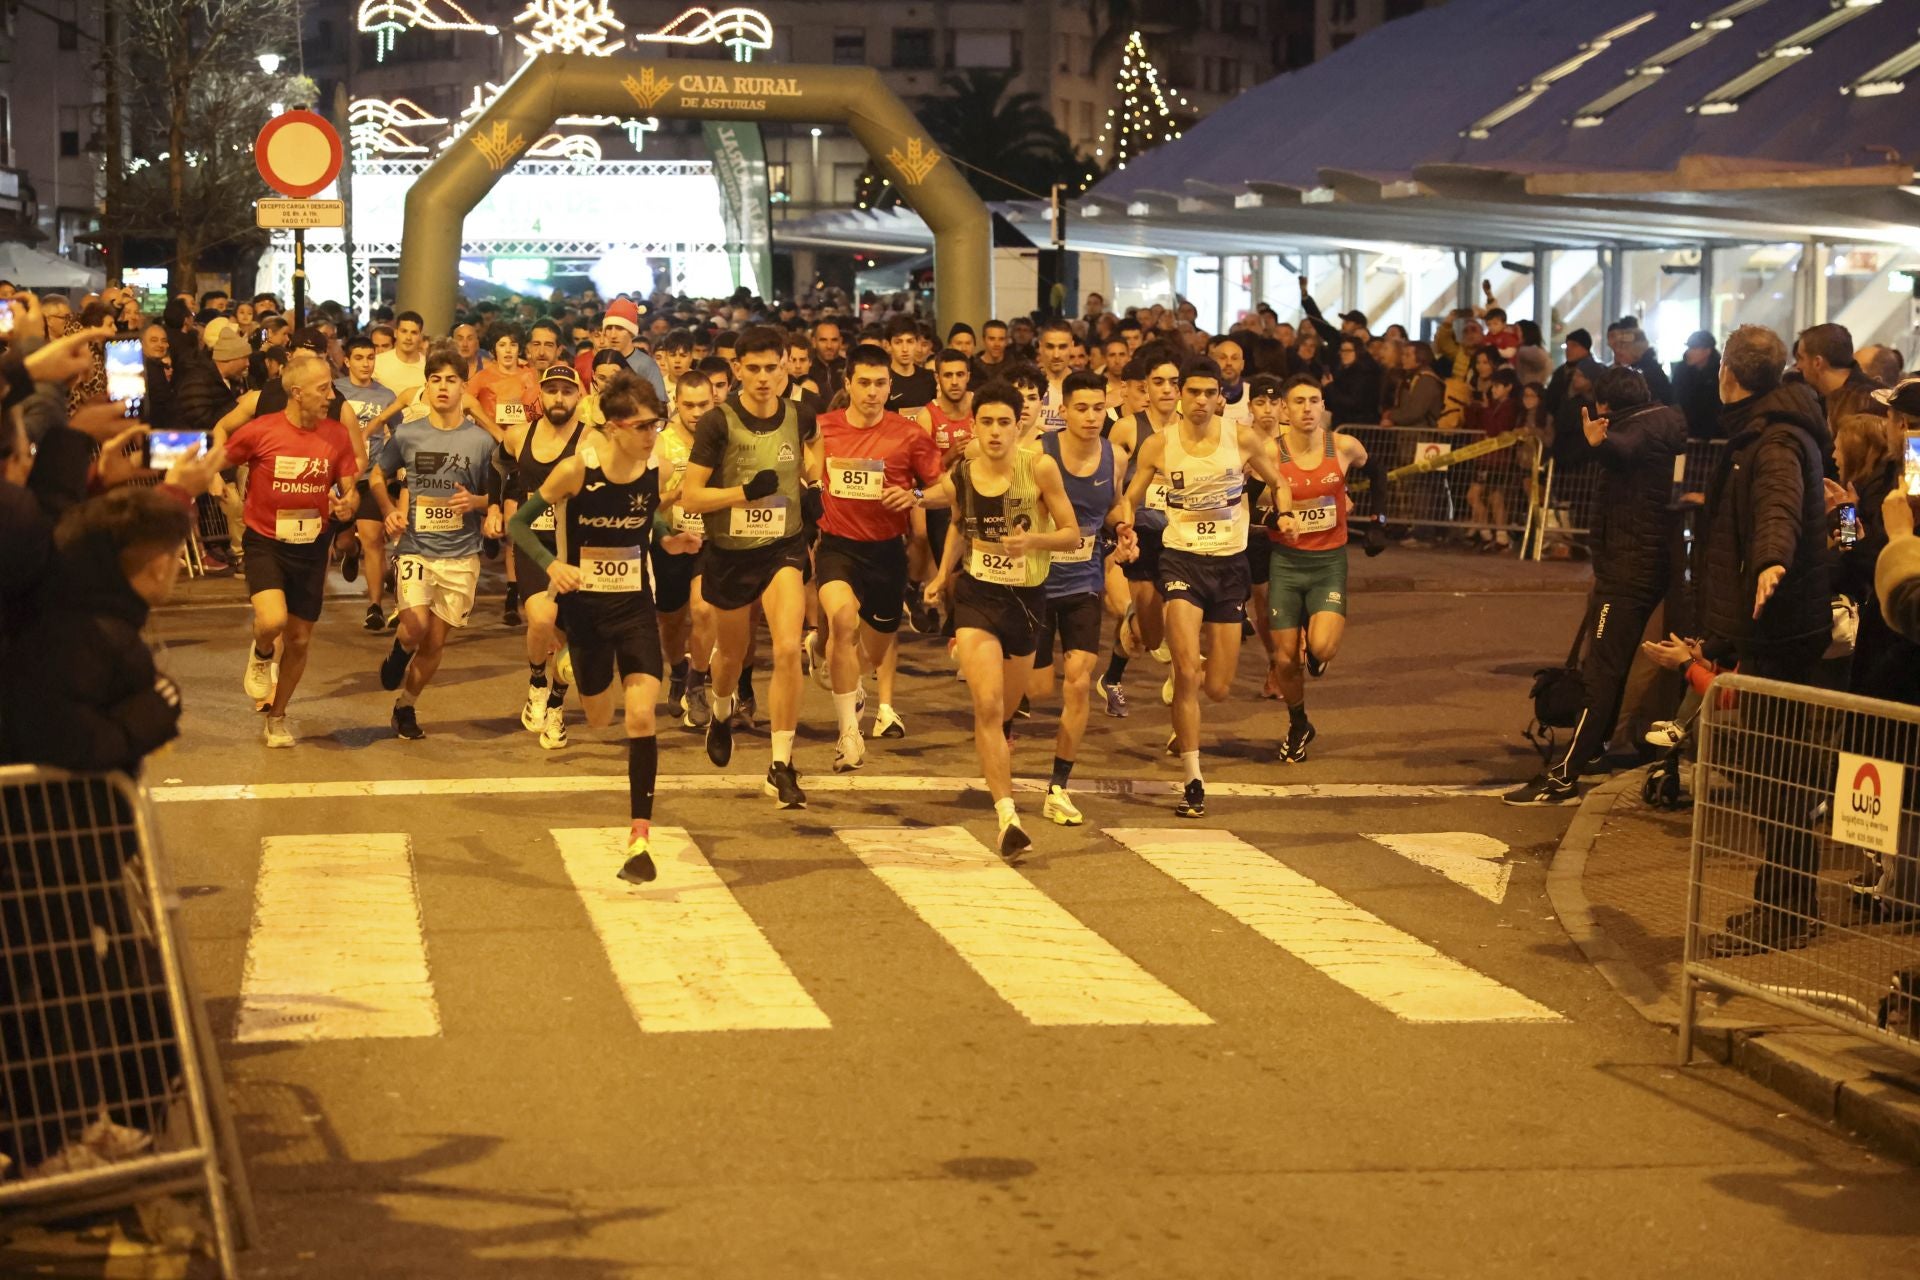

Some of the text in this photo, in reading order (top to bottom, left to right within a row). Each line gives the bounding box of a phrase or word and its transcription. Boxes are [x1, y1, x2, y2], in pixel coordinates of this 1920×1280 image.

[679, 75, 802, 96] CAJA RURAL
[680, 97, 766, 111] DE ASTURIAS
[505, 404, 522, 414] 814
[415, 478, 454, 490] PDMSi
[842, 470, 869, 485] 851
[425, 508, 453, 519] 988
[745, 509, 773, 522] 190
[1299, 508, 1326, 522] 703
[297, 520, 303, 531] 1
[578, 514, 648, 529] WOLVES
[1196, 521, 1216, 534] 82
[592, 561, 629, 577] 300
[982, 554, 1014, 570] 824
[401, 560, 424, 581] 31
[1596, 603, 1611, 639] macron
